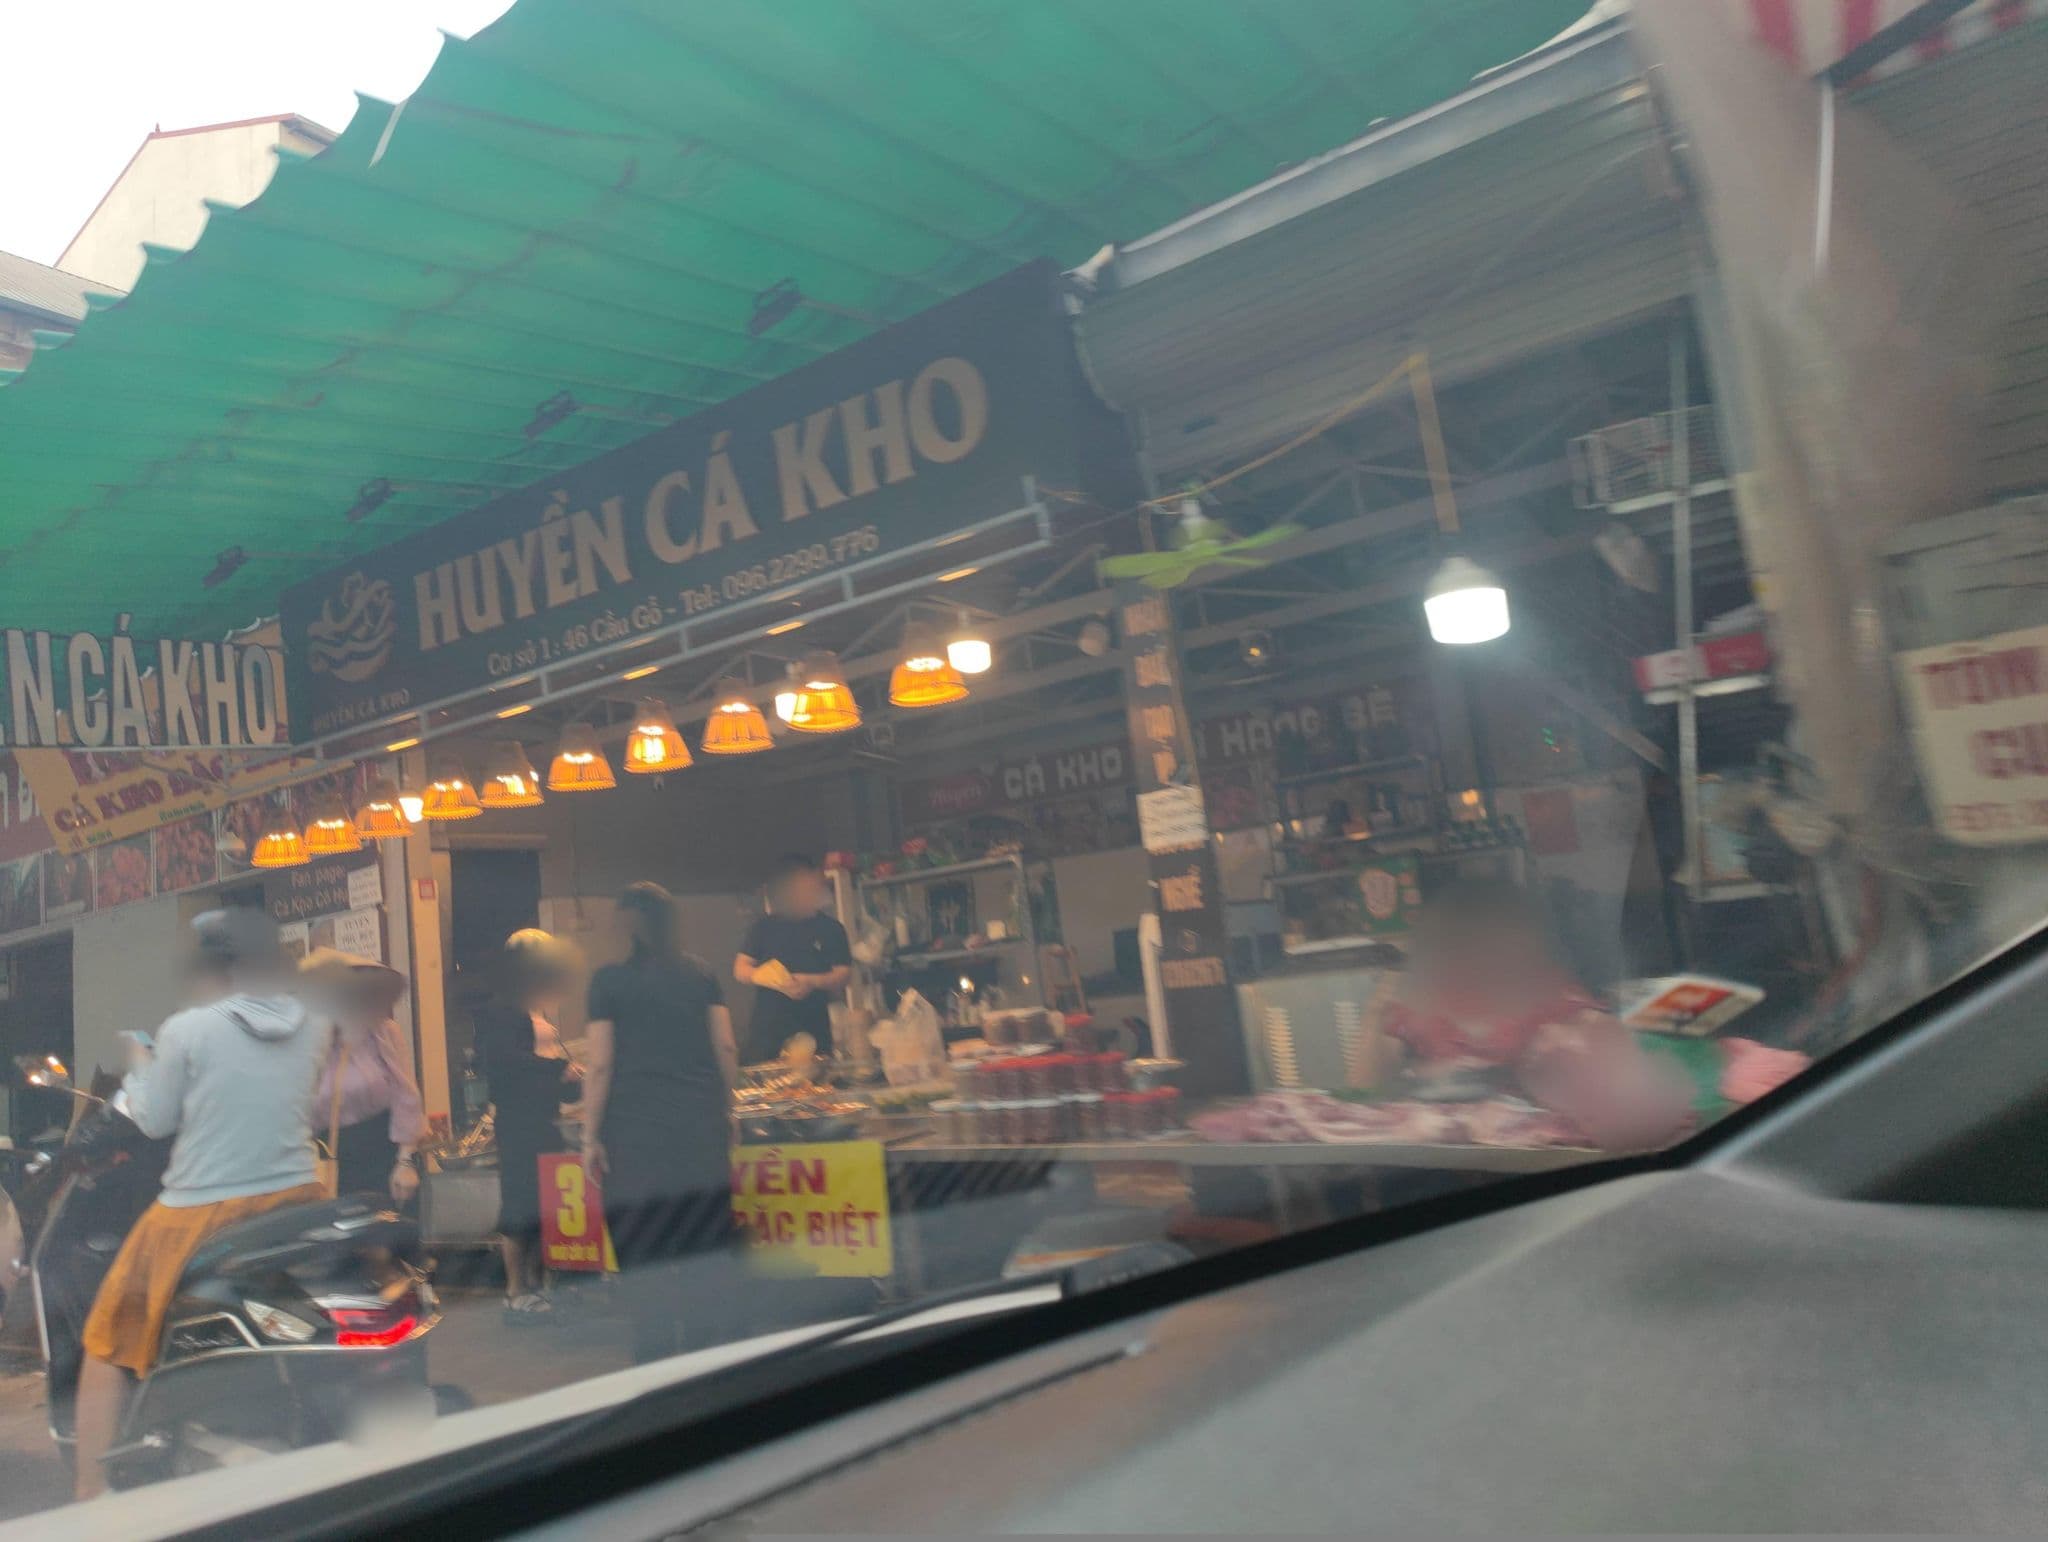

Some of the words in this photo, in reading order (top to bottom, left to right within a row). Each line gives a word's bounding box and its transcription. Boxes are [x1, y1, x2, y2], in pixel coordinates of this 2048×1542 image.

[413, 488, 633, 651] HUYỀN
[645, 429, 761, 564] CÁ
[769, 356, 988, 522] KHO
[563, 623, 590, 651] 46
[590, 608, 631, 643] Cầu
[0, 629, 57, 746] N
[69, 612, 152, 747] CÁ
[159, 638, 276, 746] KHO
[1003, 753, 1046, 799] CÁ
[1056, 746, 1123, 790] KHO
[54, 793, 98, 832] CÁ
[96, 778, 165, 820] KHO
[554, 1162, 588, 1239] 3
[805, 1200, 880, 1256] BIỆT
